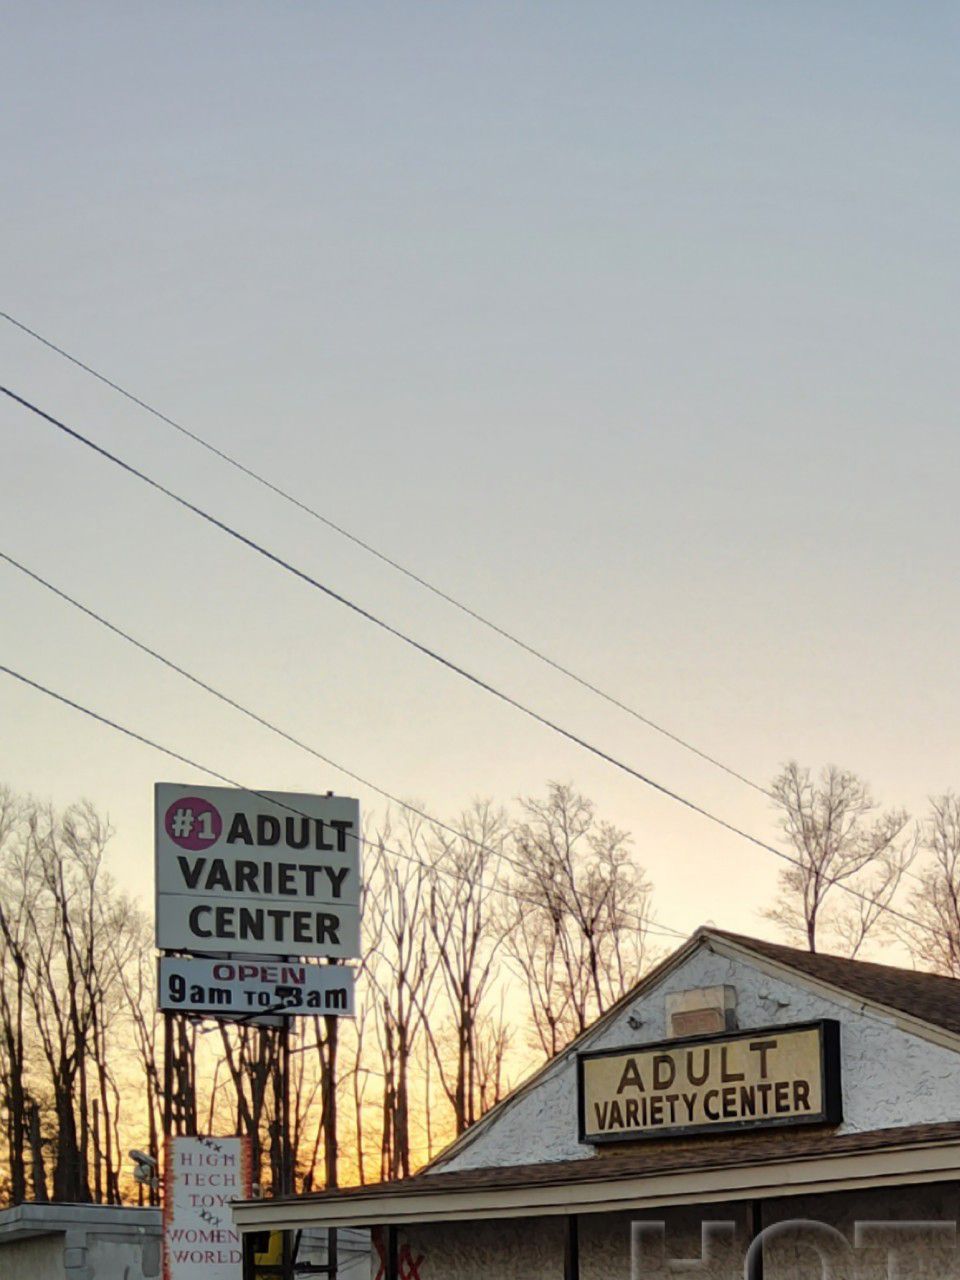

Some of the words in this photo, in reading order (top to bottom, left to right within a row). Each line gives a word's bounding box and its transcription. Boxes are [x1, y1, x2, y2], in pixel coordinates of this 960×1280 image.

[171, 808, 216, 840] #1
[226, 812, 353, 852] ADULT
[176, 855, 350, 898] VARIETY
[188, 905, 341, 945] CENTER
[168, 974, 232, 1004] 9am
[213, 964, 306, 984] OPEN
[616, 1040, 777, 1095] ADULT
[594, 1092, 697, 1131] VARIETY
[703, 1079, 811, 1122] CENTER
[181, 1152, 235, 1167] HIGH
[182, 1173, 236, 1187] TECH
[172, 1250, 243, 1264] WORLD
